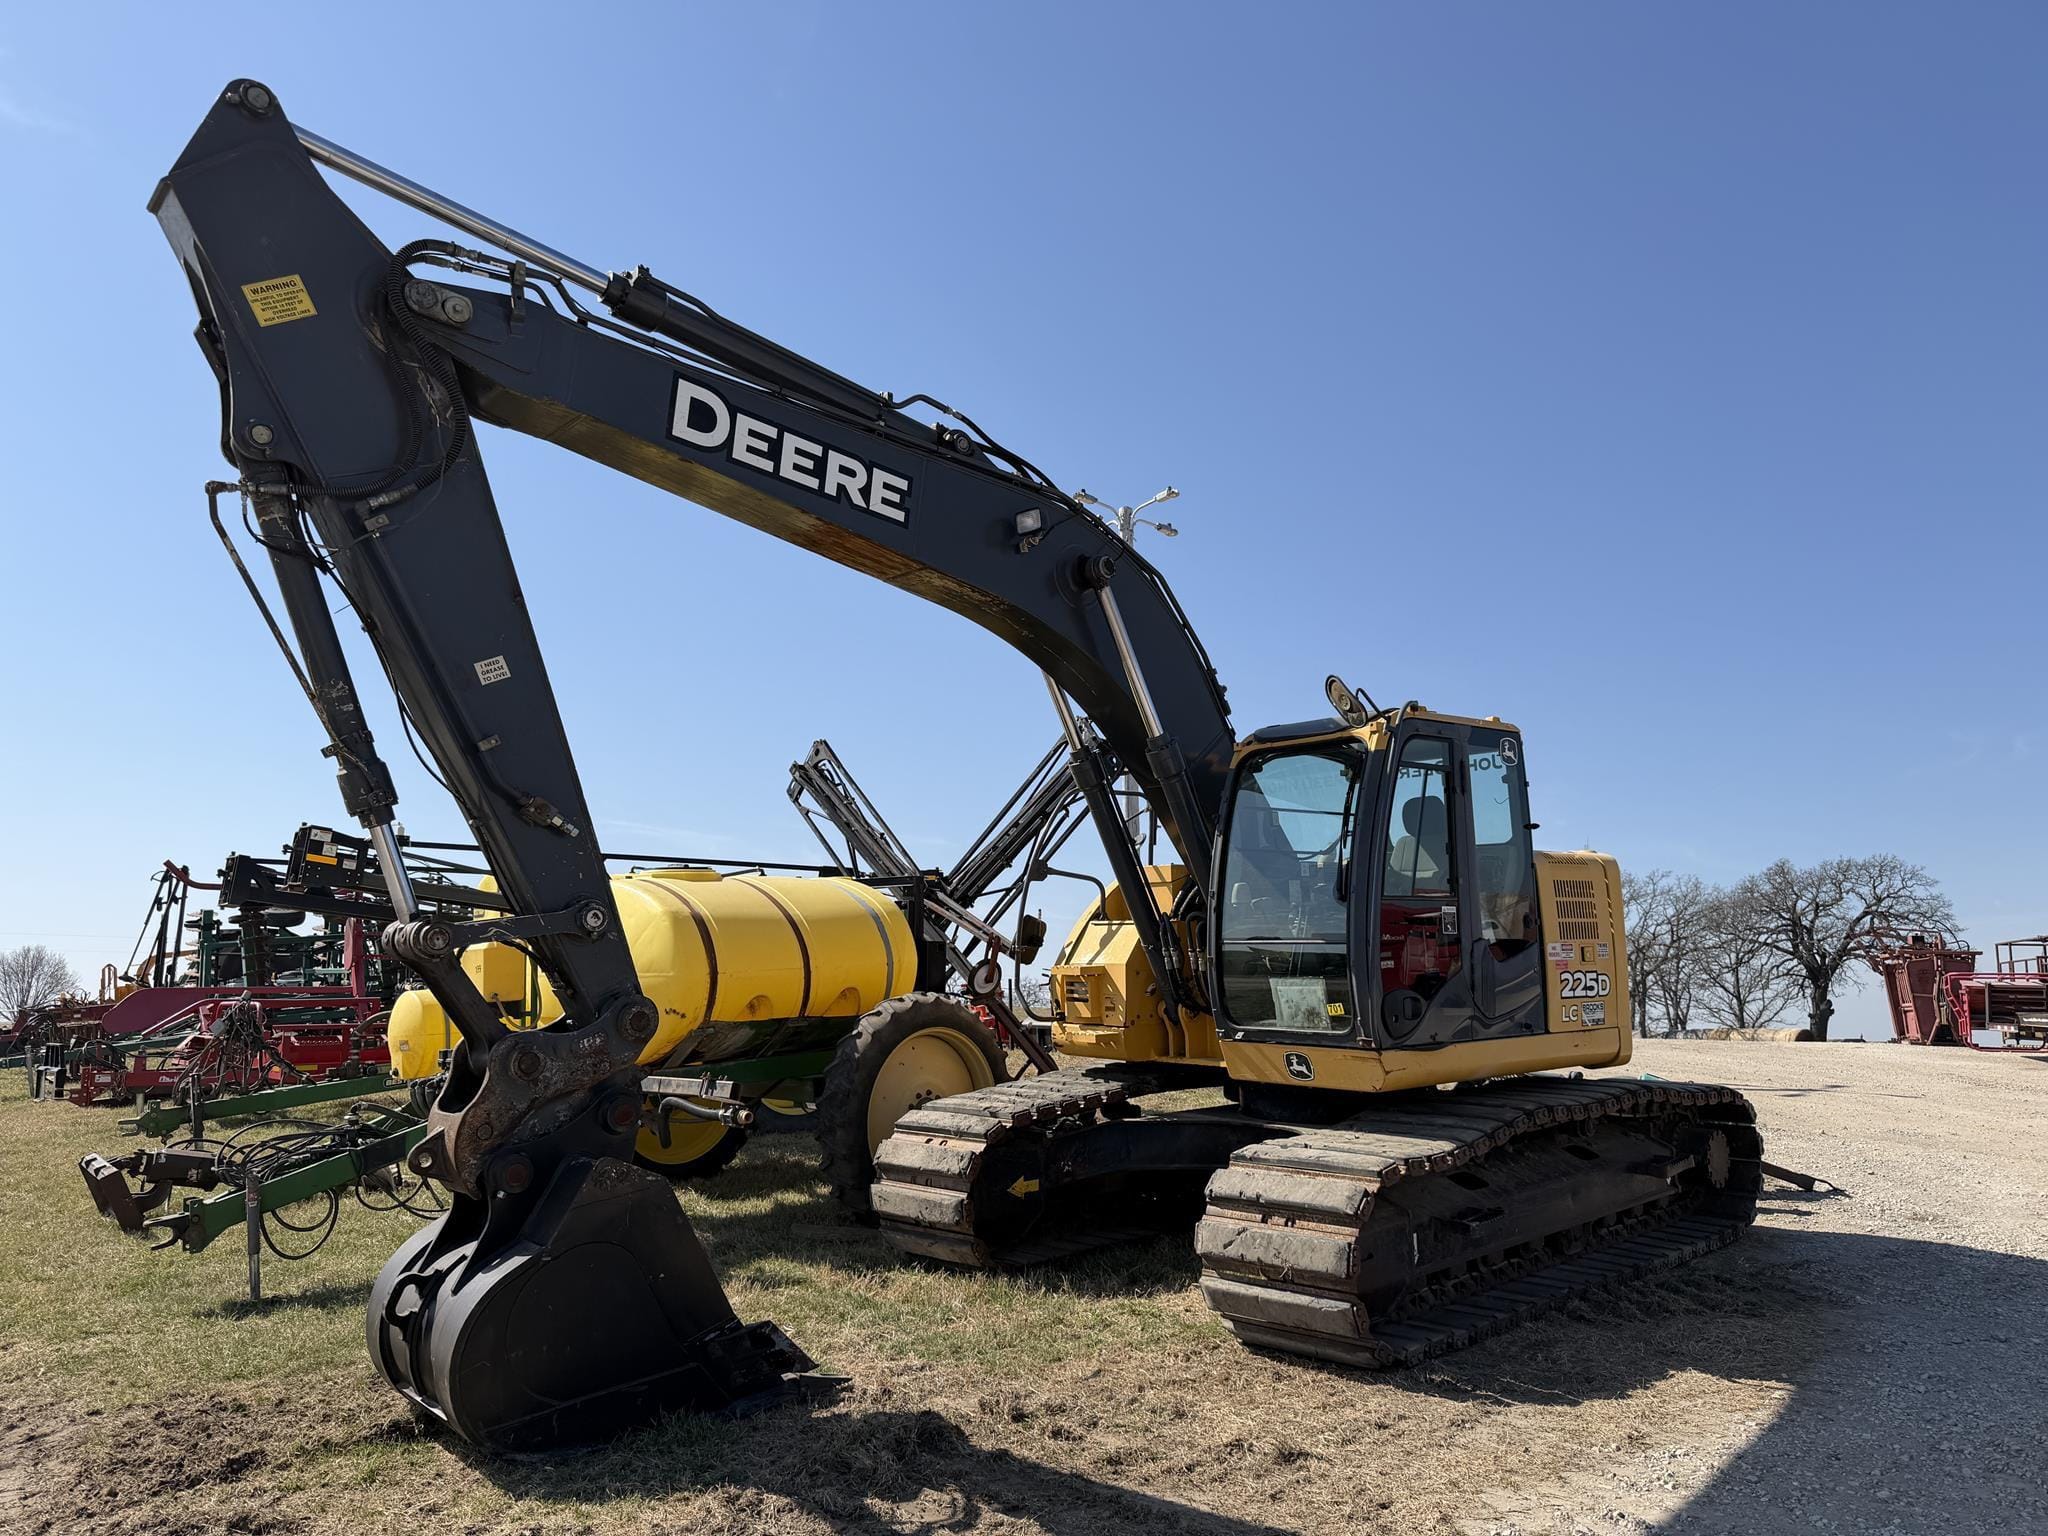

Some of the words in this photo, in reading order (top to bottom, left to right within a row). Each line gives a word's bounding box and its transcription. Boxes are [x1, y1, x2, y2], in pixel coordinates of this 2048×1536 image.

[250, 280, 297, 295] WARNING
[672, 378, 909, 523] DEERE
[481, 664, 505, 676] GREASE
[484, 659, 500, 668] NEED
[492, 671, 508, 680] LIVE!
[1560, 971, 1610, 998] 225D
[1328, 1004, 1343, 1014] 701
[1562, 1005, 1578, 1022] LC
